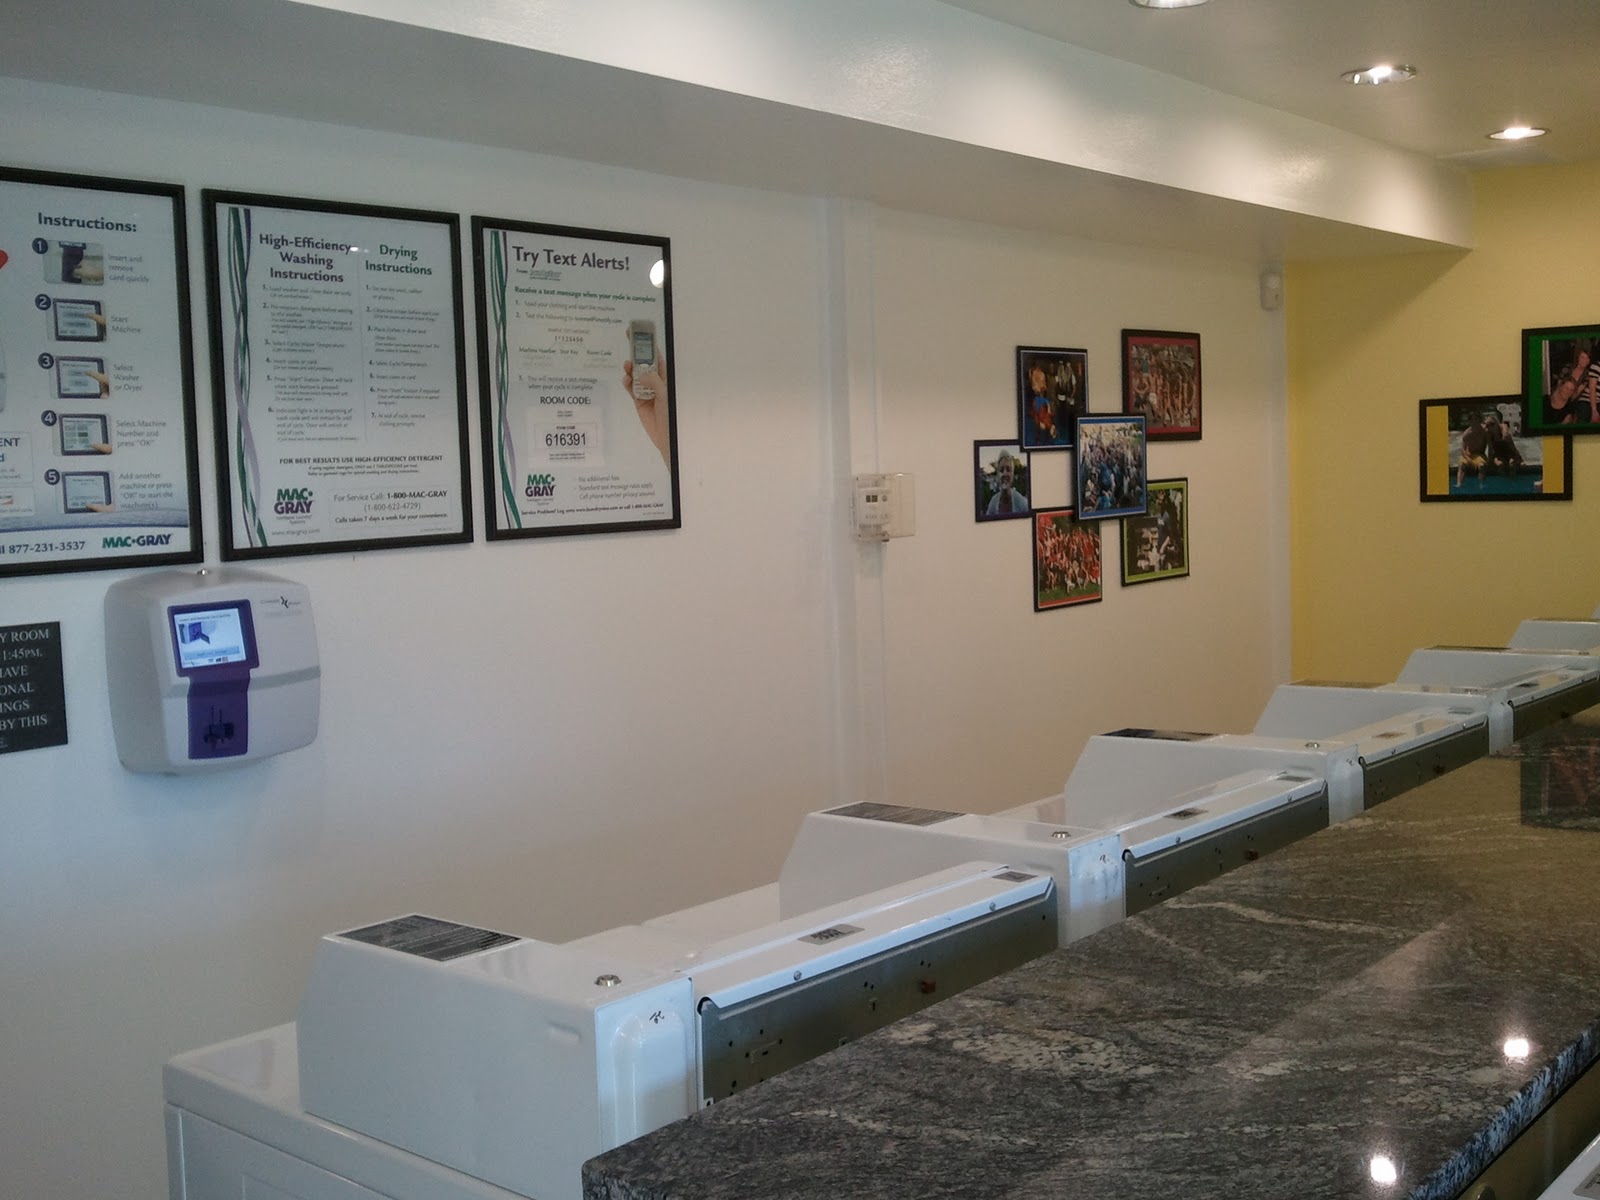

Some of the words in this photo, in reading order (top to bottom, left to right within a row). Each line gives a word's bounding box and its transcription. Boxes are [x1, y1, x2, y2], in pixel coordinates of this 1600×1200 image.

[38, 212, 137, 232] Instructions:
[259, 233, 351, 255] High-Efficiency
[379, 244, 418, 262] Drying
[512, 245, 539, 268] Try
[543, 248, 577, 266] Text
[581, 252, 630, 271] Alerts!
[279, 251, 334, 270] Washing
[365, 260, 432, 276] Instructions
[270, 267, 344, 283] Instructions
[514, 286, 537, 294] Receive
[543, 288, 555, 296] text
[556, 290, 582, 299] message
[598, 293, 611, 301] your
[612, 293, 625, 301] cycle
[38, 297, 47, 307] 2
[111, 315, 128, 323] Start
[112, 325, 141, 334] Machine
[114, 363, 133, 371] Select
[114, 373, 139, 381] Washer
[123, 383, 143, 392] Dryer
[540, 396, 565, 405] ROOM
[567, 396, 591, 405] CODE:
[44, 413, 54, 423] 4
[116, 420, 135, 428] Select
[117, 430, 144, 438] Number
[545, 432, 586, 447] 616391
[279, 457, 294, 465] FOR
[295, 457, 311, 465] BEST
[312, 456, 340, 464] RESULTS
[355, 455, 406, 463] HIGH-EFFICIENCY
[408, 454, 443, 462] DETERGENT
[334, 494, 345, 502] For
[346, 493, 368, 501] Service
[386, 490, 448, 499] 1-800-MAC-GRAY
[525, 485, 556, 497] GRAY
[274, 500, 313, 514] GRAY
[364, 502, 421, 512] (1-800-622-4729)
[335, 516, 347, 524] Calls
[368, 514, 380, 523] days
[407, 514, 418, 522] your
[9, 541, 86, 553] 877-231-3537
[10, 628, 50, 643] ROOM
[18, 714, 48, 728] THIS
